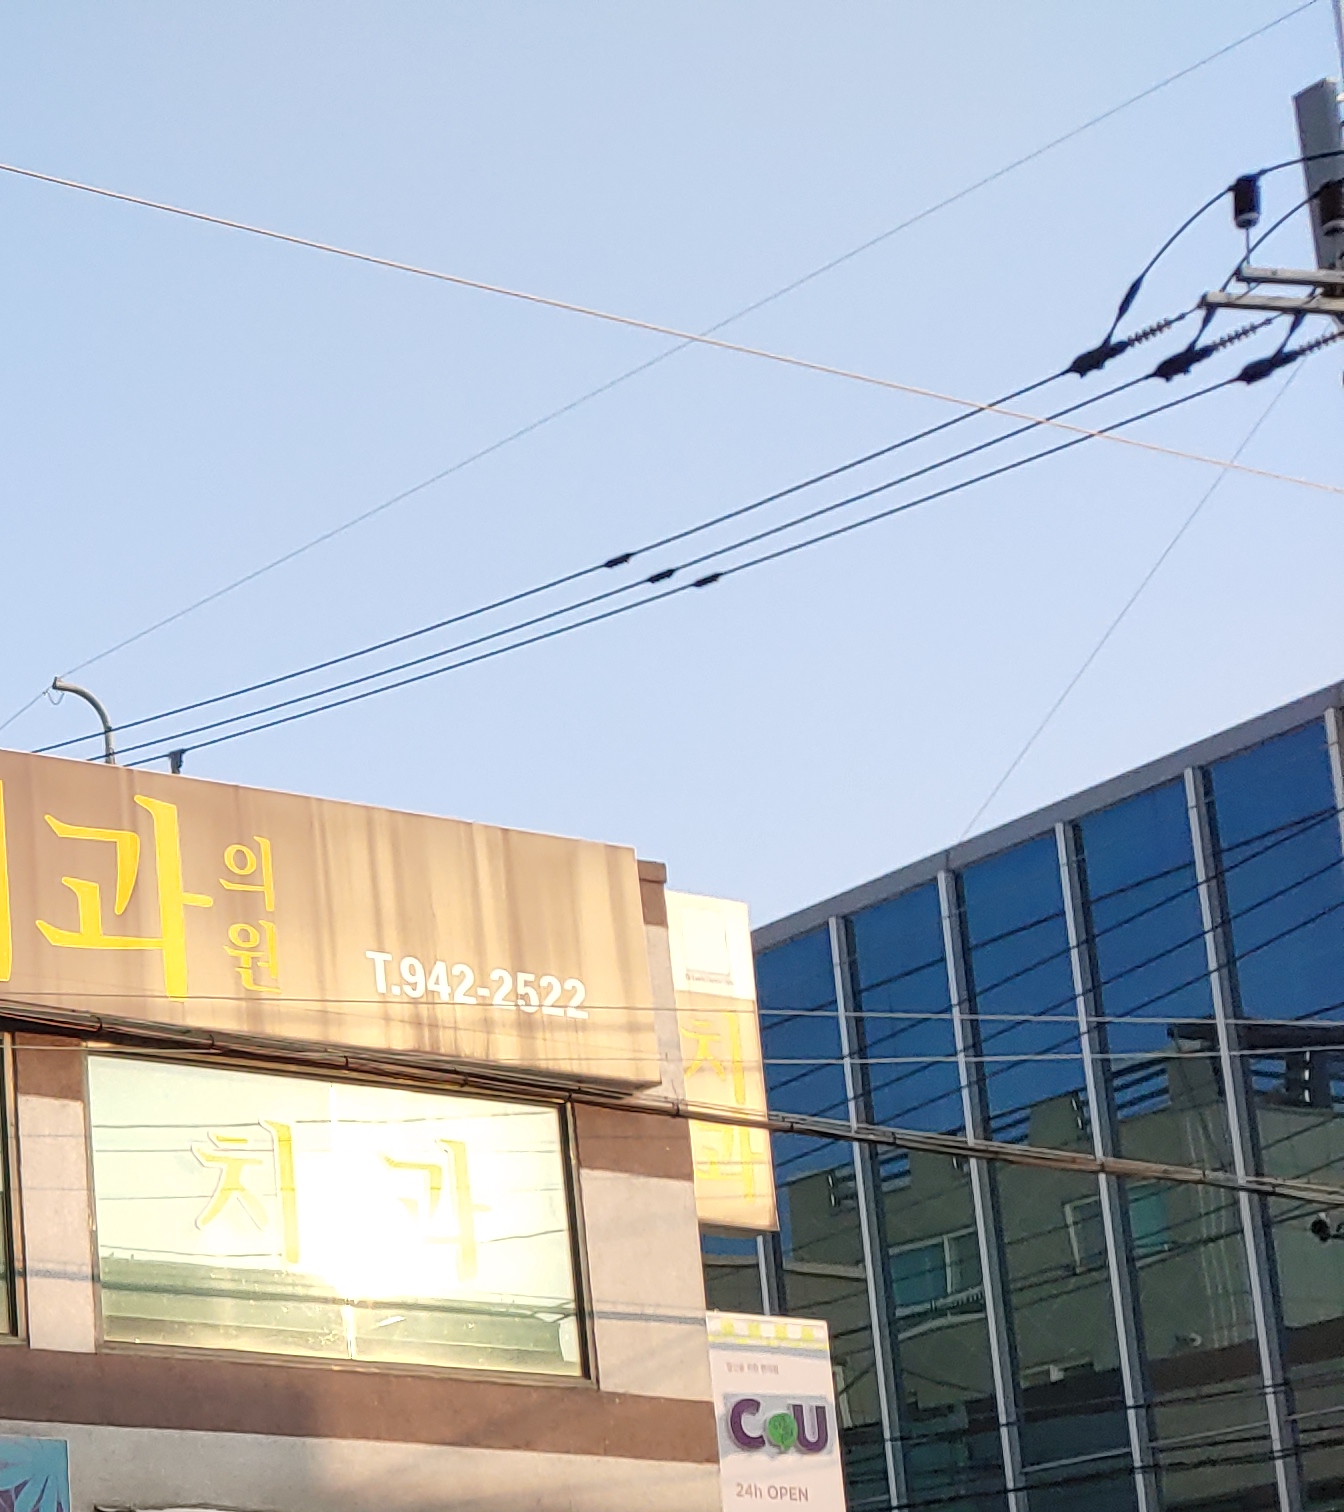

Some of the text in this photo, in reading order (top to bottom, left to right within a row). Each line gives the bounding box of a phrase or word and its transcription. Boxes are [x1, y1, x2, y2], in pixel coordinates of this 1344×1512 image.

[365, 950, 589, 1021] T.942-2522
[728, 1397, 829, 1453] CU
[735, 1482, 809, 1503] 24h OPEN
